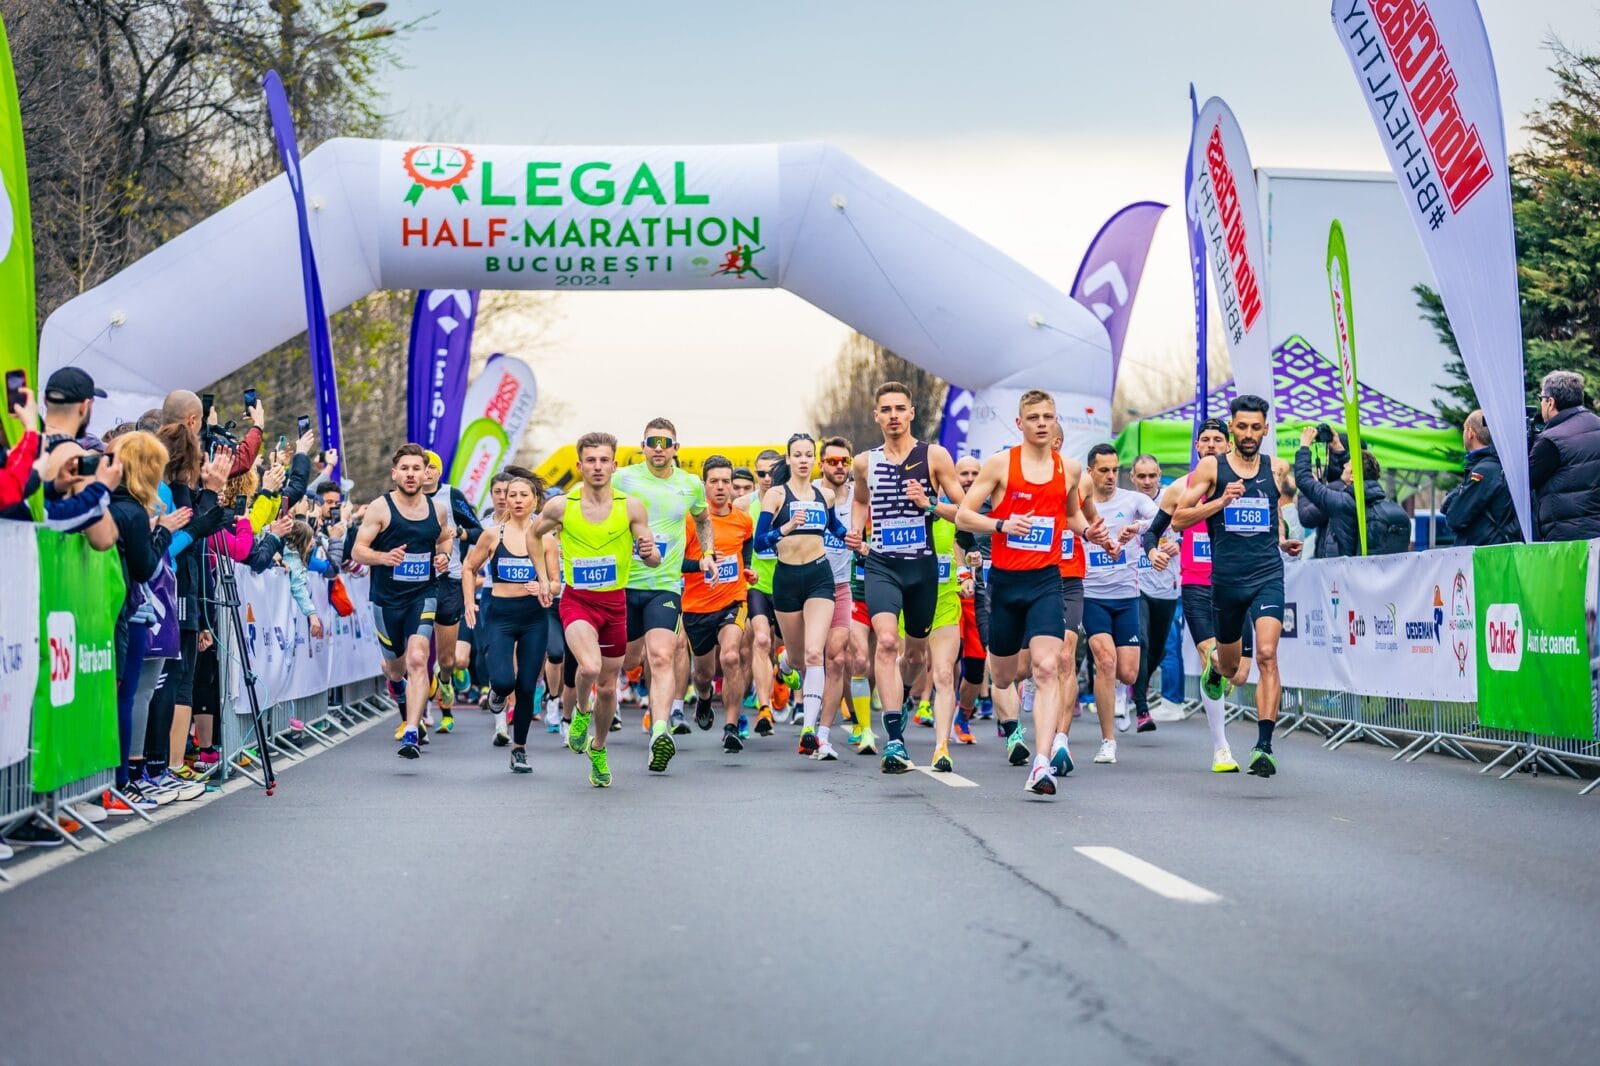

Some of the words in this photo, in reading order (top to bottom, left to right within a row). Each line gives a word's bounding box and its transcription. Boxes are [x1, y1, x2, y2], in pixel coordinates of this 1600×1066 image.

[481, 161, 709, 206] LEGAL
[402, 216, 761, 248] HALF-MARATHON
[555, 275, 612, 286] 2024
[1234, 509, 1262, 523] 1568
[890, 529, 917, 543] 1414
[402, 563, 425, 575] 1432
[505, 568, 530, 579] 1362
[582, 568, 608, 582] 1467
[718, 565, 734, 576] 260
[1405, 621, 1434, 640] DEDEMAN
[1489, 621, 1517, 655] Dr.Max
